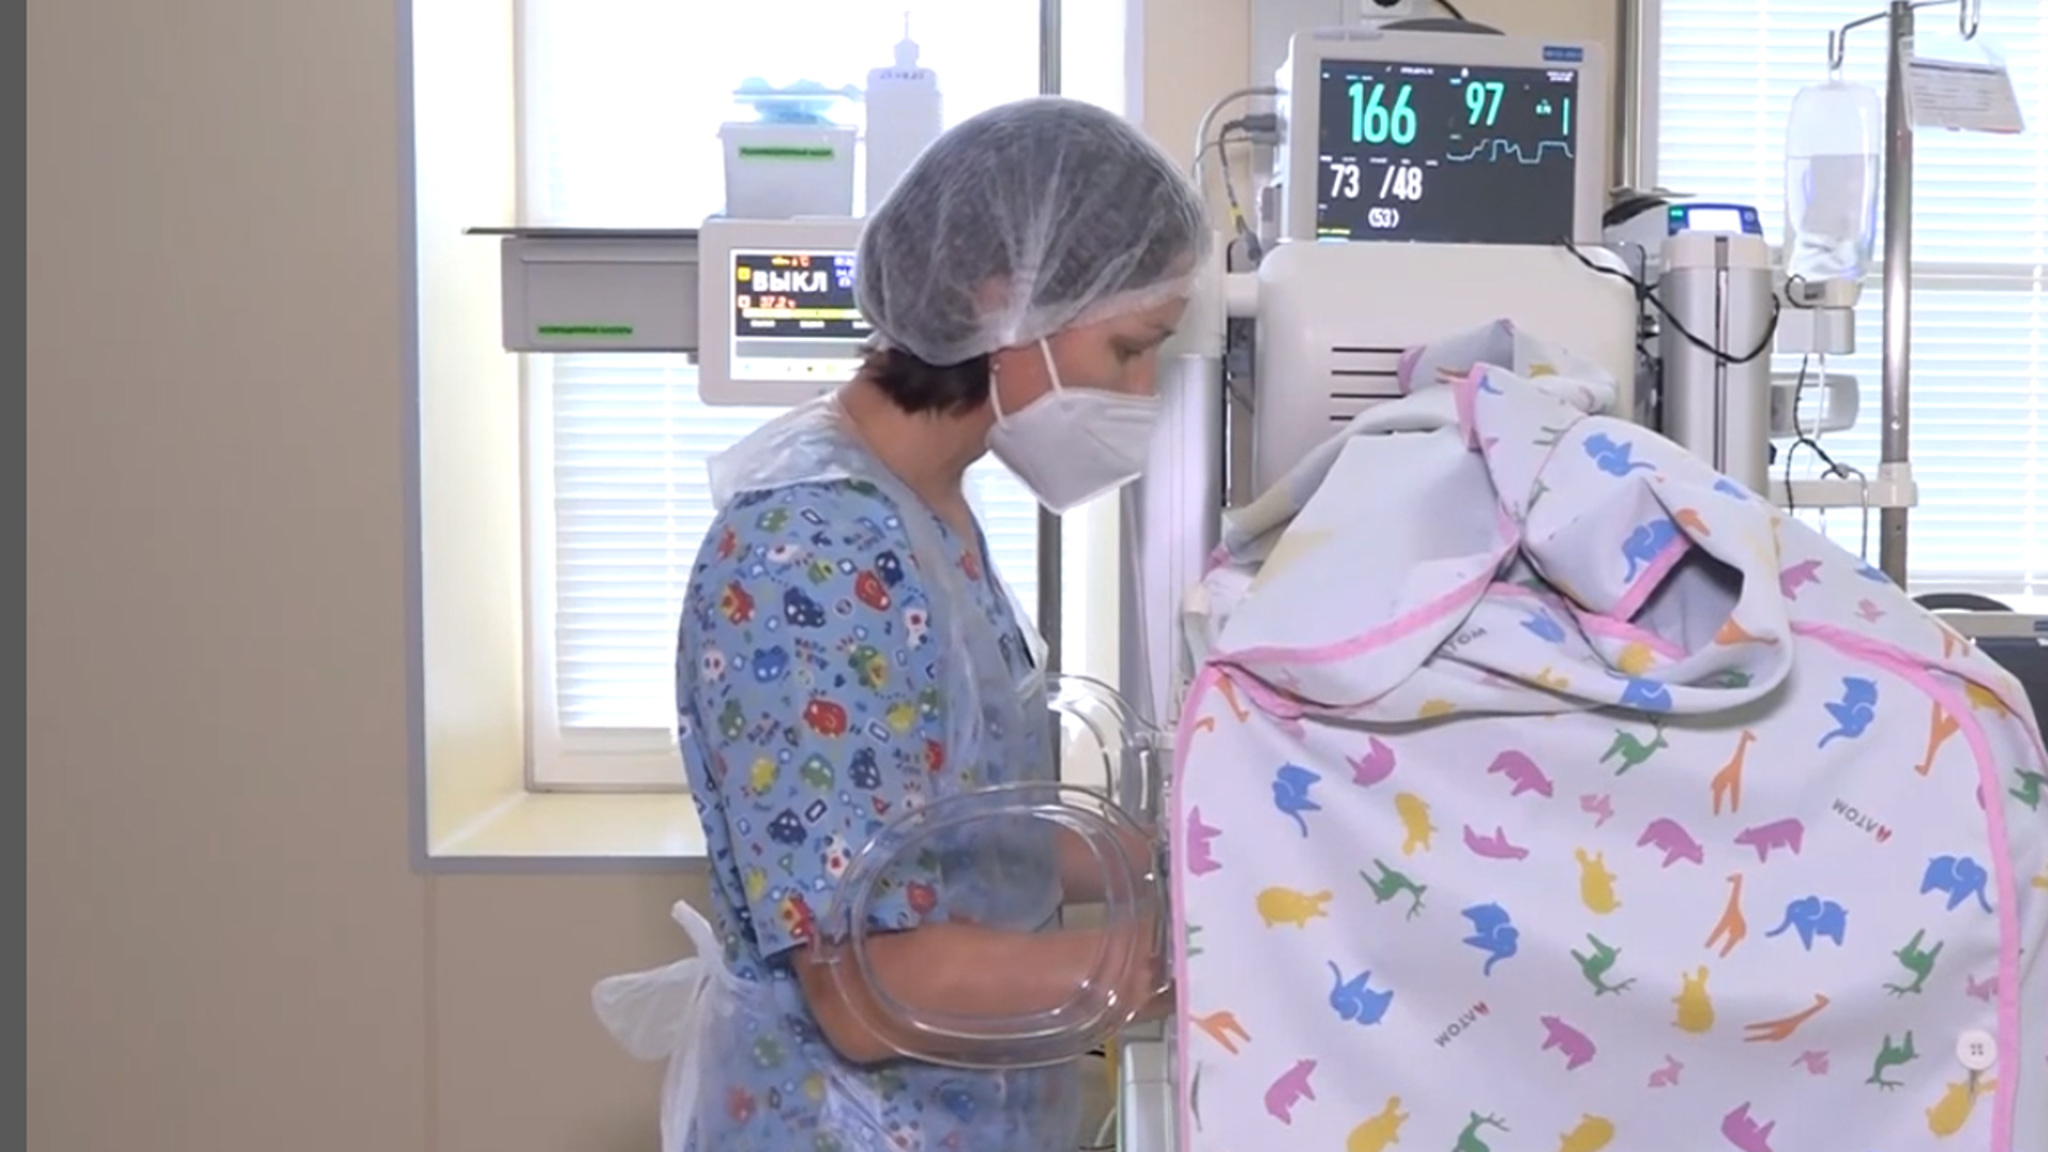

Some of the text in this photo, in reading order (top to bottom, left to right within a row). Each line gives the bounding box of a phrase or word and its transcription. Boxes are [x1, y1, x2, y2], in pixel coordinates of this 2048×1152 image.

[1348, 82, 1417, 144] 166
[1465, 81, 1504, 126] 97
[1330, 163, 1360, 199] 73
[1368, 207, 1400, 229] (53)
[753, 271, 828, 292] ВЫКЛ
[1832, 797, 1879, 833] ATOM
[1434, 1008, 1477, 1048] ATOM
